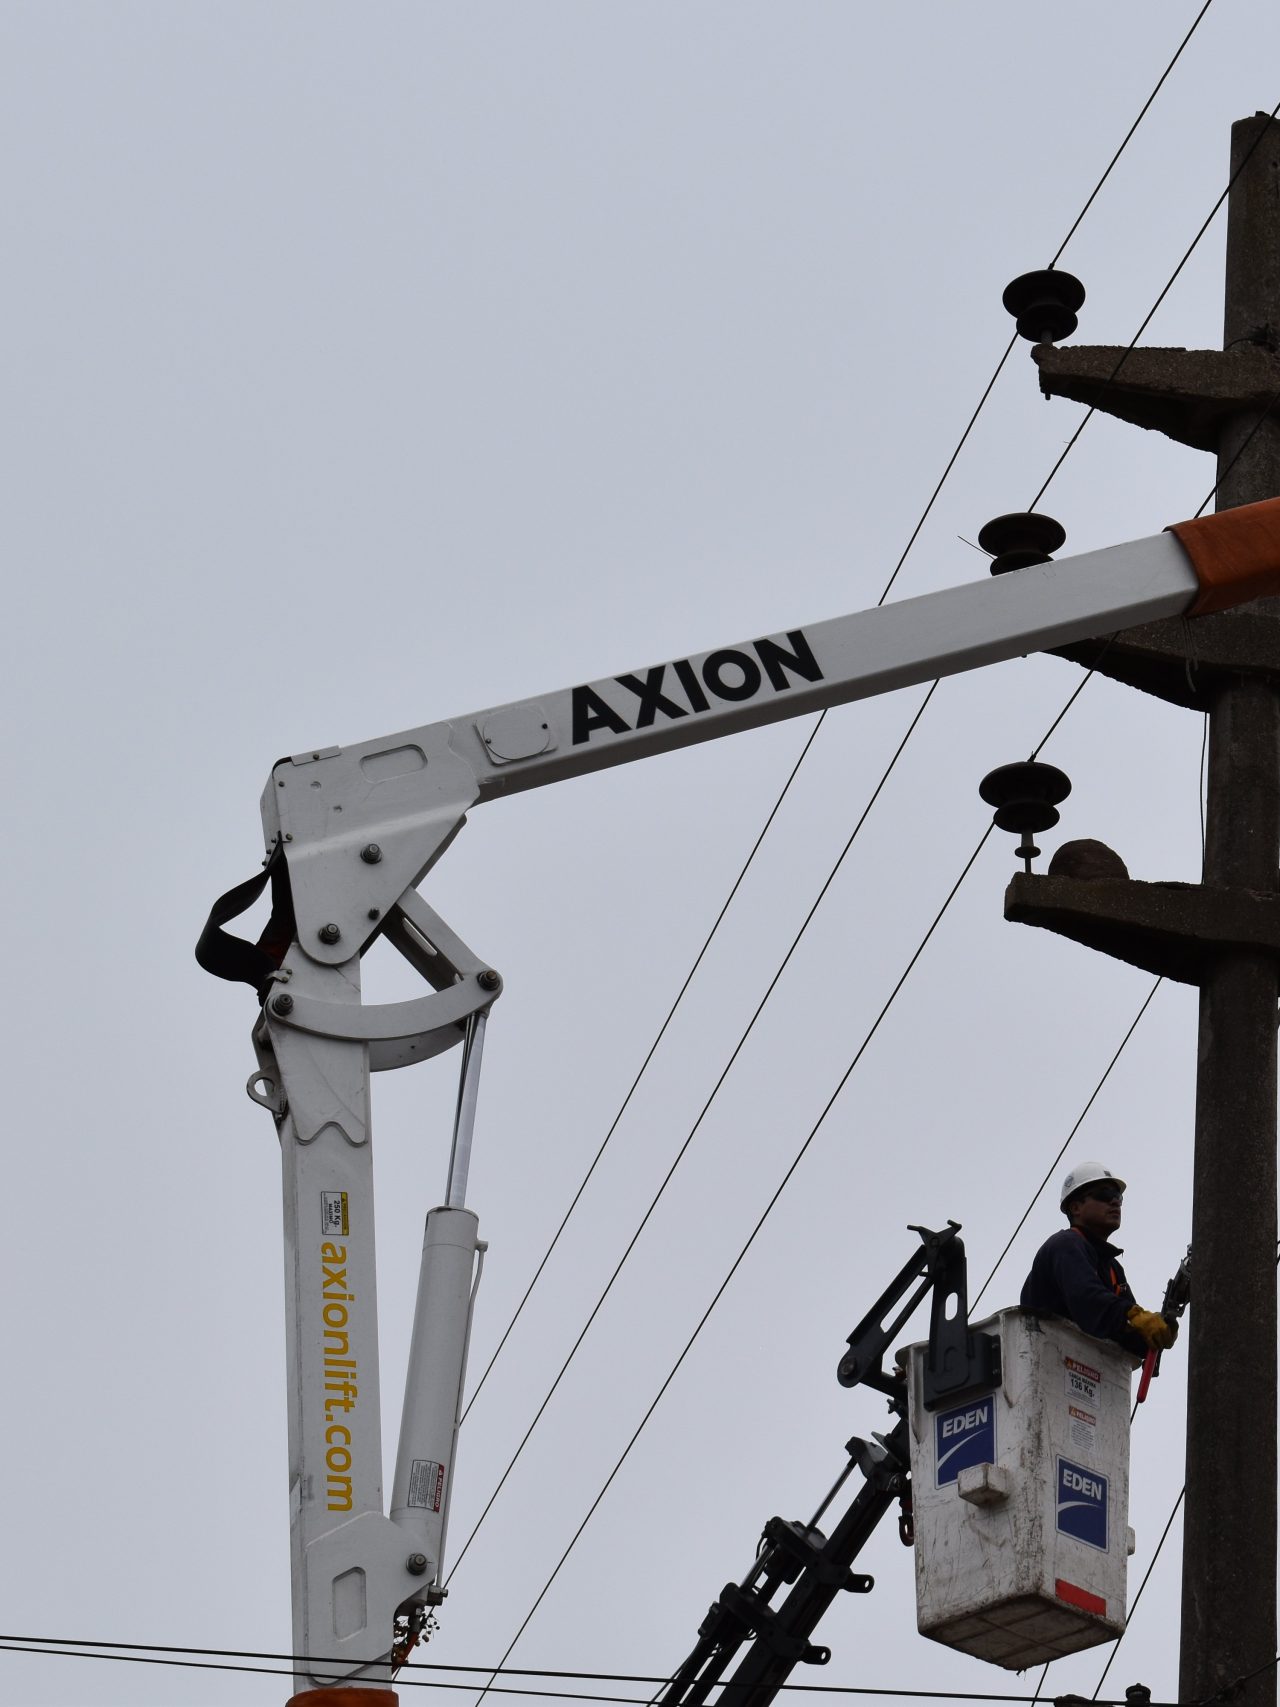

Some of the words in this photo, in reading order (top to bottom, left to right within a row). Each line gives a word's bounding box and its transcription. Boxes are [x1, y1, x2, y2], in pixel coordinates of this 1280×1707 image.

[572, 630, 824, 745] AXION
[320, 1241, 358, 1512] axionlift.com
[1070, 1378, 1083, 1391] 136
[1072, 1361, 1100, 1380] PELIGRO
[942, 1405, 988, 1438] EDEN
[434, 1475, 443, 1508] PELIGRO
[1063, 1468, 1102, 1501] EDEN
